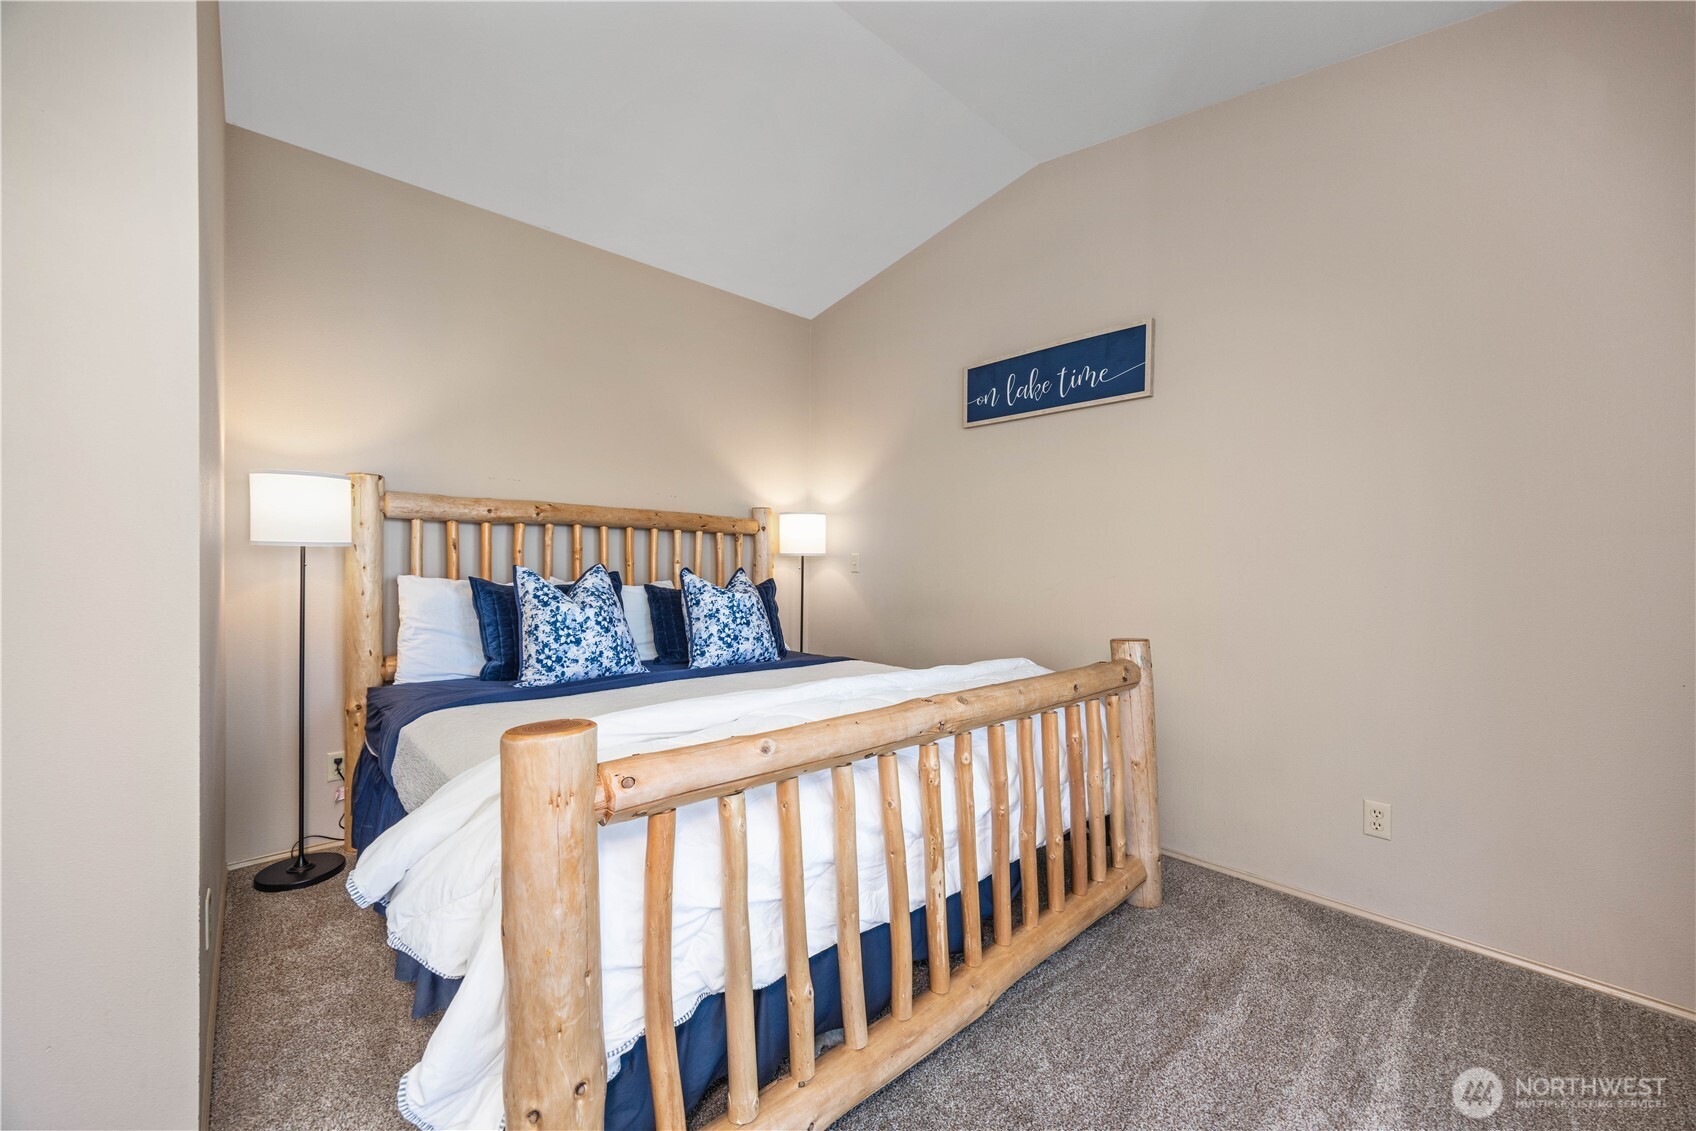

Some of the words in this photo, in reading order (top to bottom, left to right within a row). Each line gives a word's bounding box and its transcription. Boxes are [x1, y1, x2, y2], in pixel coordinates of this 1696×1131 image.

[967, 387, 1000, 407] on
[1006, 367, 1052, 406] lake
[1057, 362, 1146, 398] time
